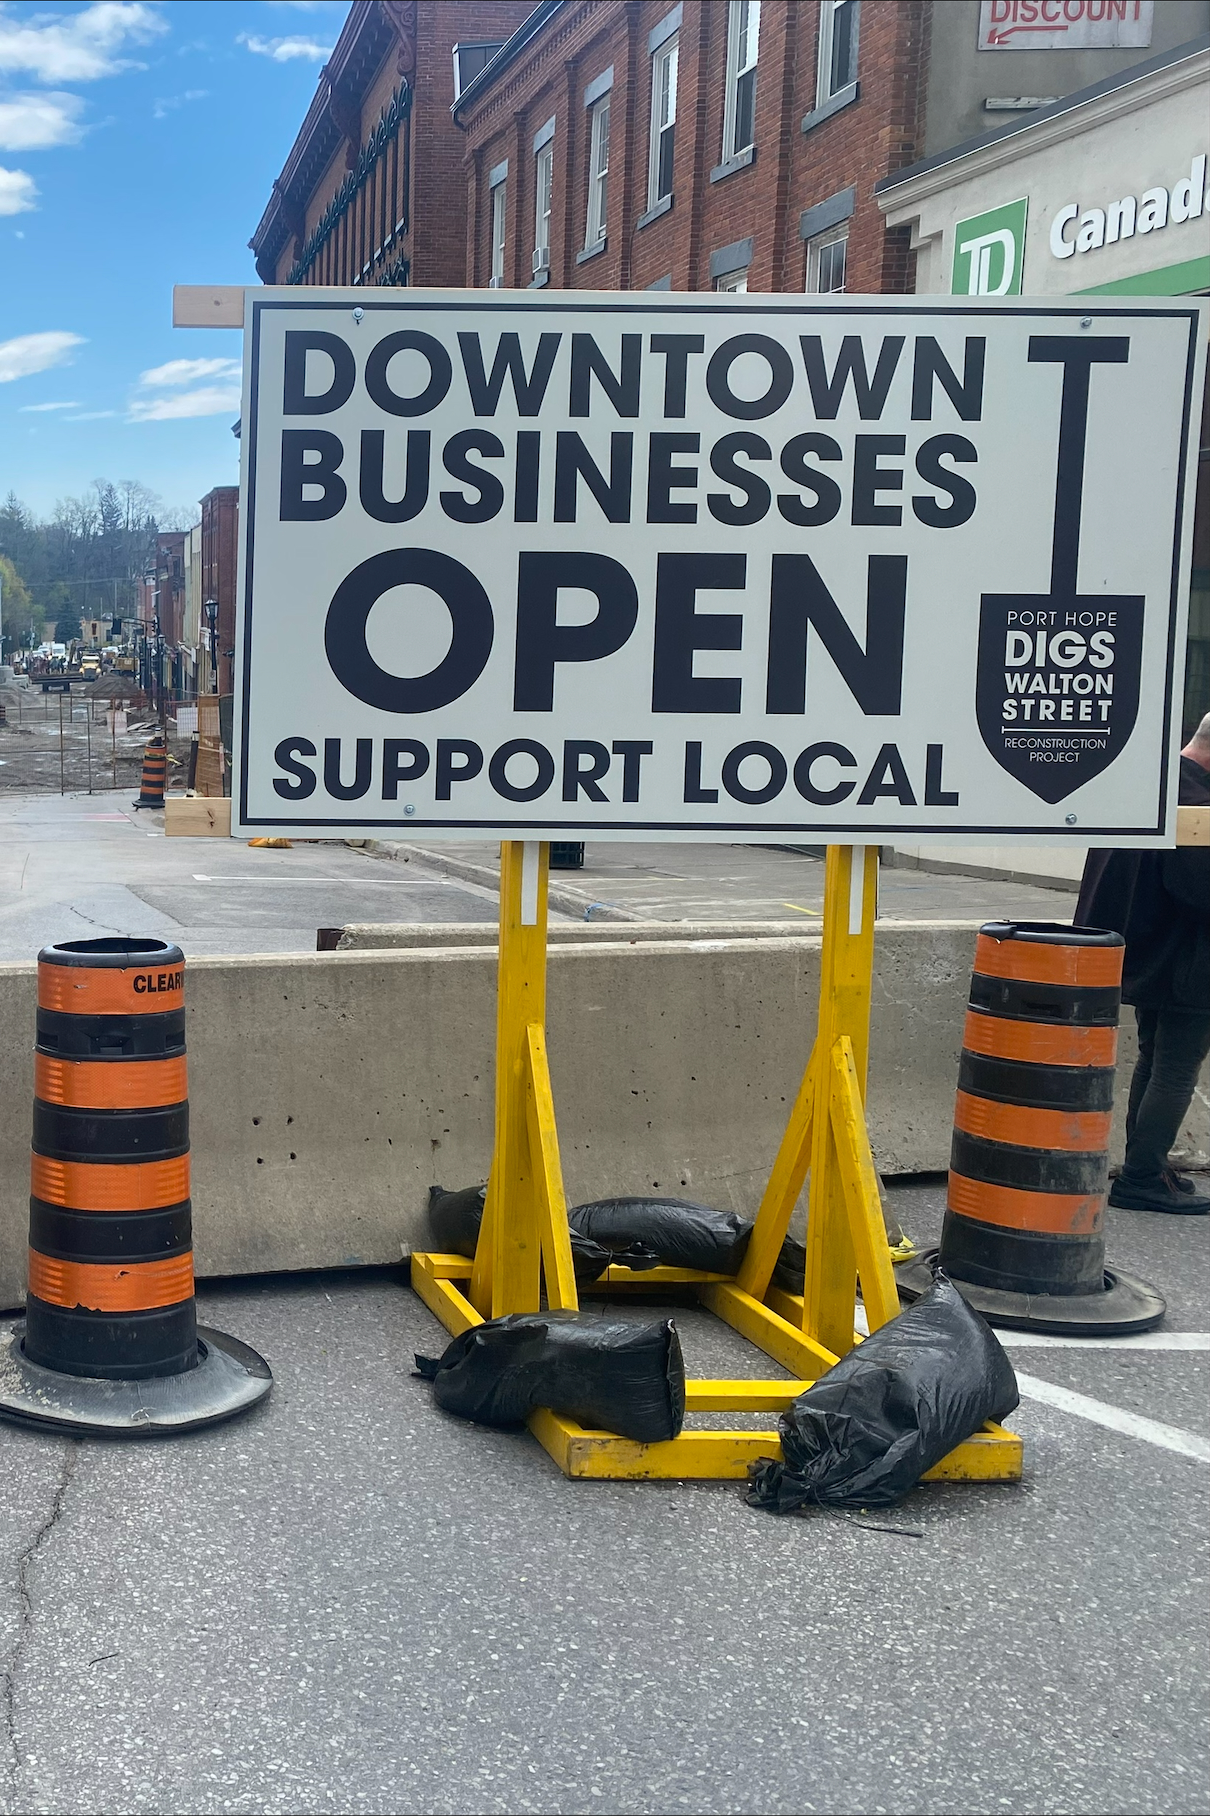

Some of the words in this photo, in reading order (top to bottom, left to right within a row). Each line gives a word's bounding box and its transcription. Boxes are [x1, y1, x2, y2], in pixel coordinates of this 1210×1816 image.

[960, 229, 1016, 295] TD
[1050, 154, 1210, 259] Canad
[283, 330, 986, 421] DOWNTOWN
[280, 429, 978, 528] BUSINESSES
[324, 548, 908, 715] OPEN
[1007, 611, 1057, 625] PORT
[1065, 612, 1117, 626] HOPE
[1005, 631, 1115, 668] DIGS
[1005, 673, 1114, 694] WALTON
[1003, 699, 1112, 721] STREET
[1005, 738, 1106, 749] RECONSTRUCTION
[1030, 752, 1080, 762] PROJECT
[273, 737, 653, 802] SUPPORT
[684, 741, 959, 806] LOCAL
